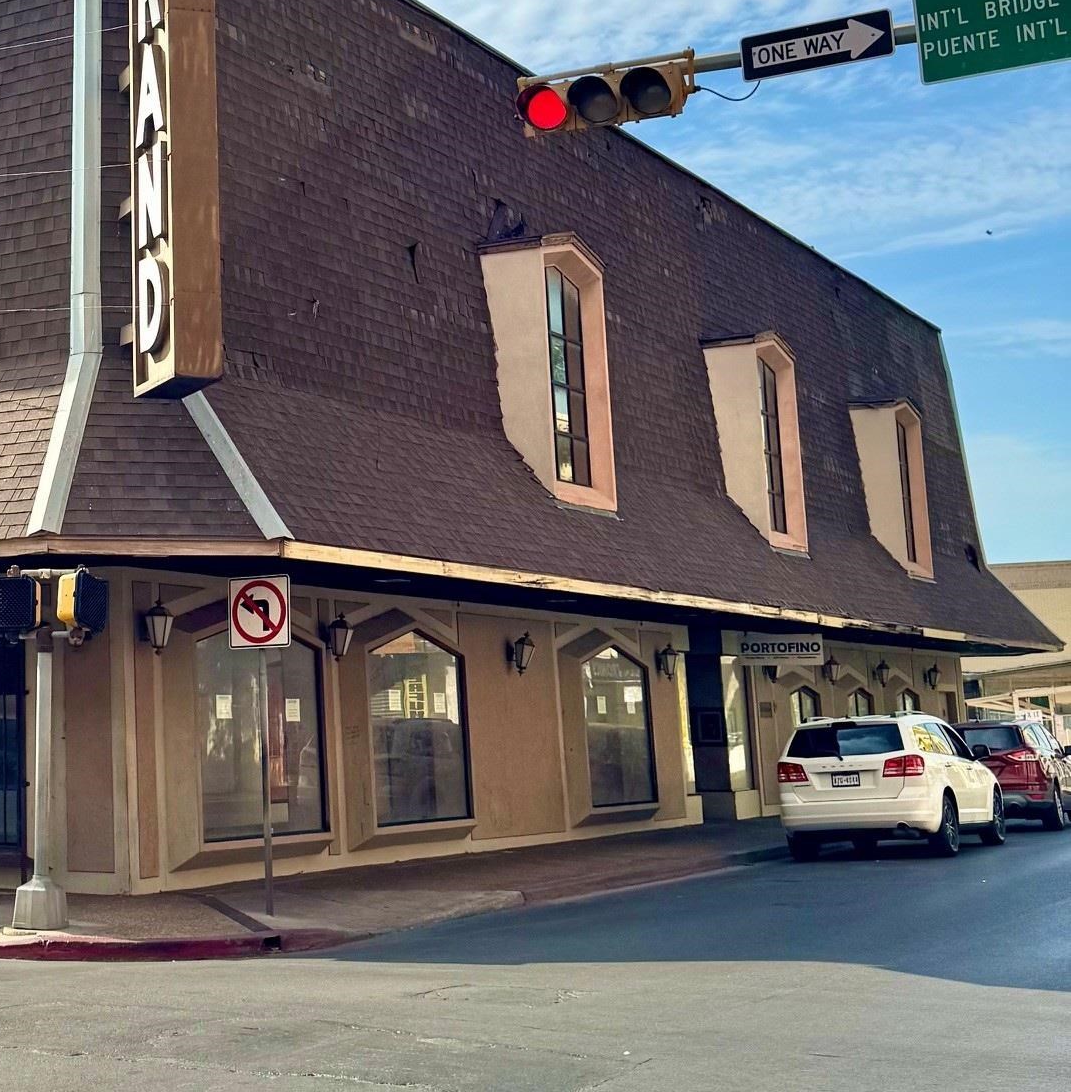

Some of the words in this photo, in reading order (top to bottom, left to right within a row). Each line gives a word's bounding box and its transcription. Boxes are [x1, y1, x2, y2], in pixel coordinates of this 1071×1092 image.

[920, 7, 969, 32] INT'L
[758, 42, 797, 64] ONE
[804, 32, 844, 56] WAY
[923, 29, 1001, 60] PUENTE
[1016, 17, 1067, 43] INT'L
[741, 642, 821, 654] PORTOFINO
